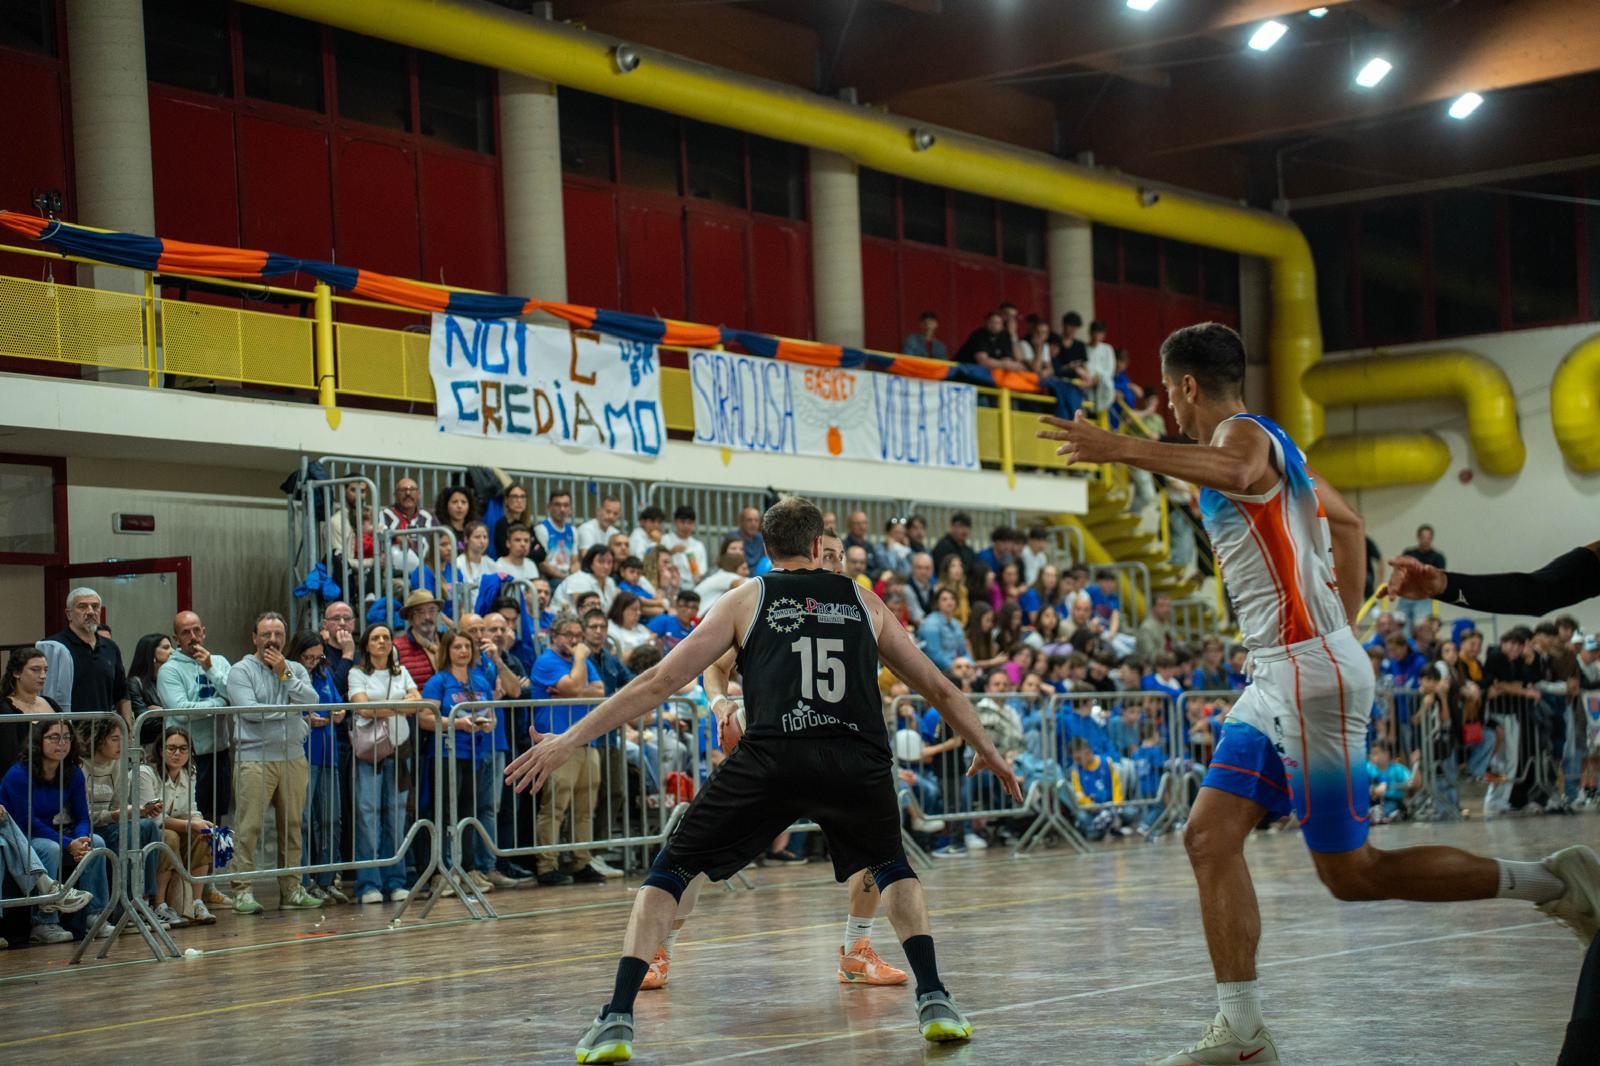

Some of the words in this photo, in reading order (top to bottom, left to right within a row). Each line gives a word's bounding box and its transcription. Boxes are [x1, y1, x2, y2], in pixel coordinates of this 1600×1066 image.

[445, 315, 528, 377] NOI
[692, 352, 797, 455] SIRACUSA
[803, 367, 857, 401] BASKET
[791, 636, 846, 704] 15
